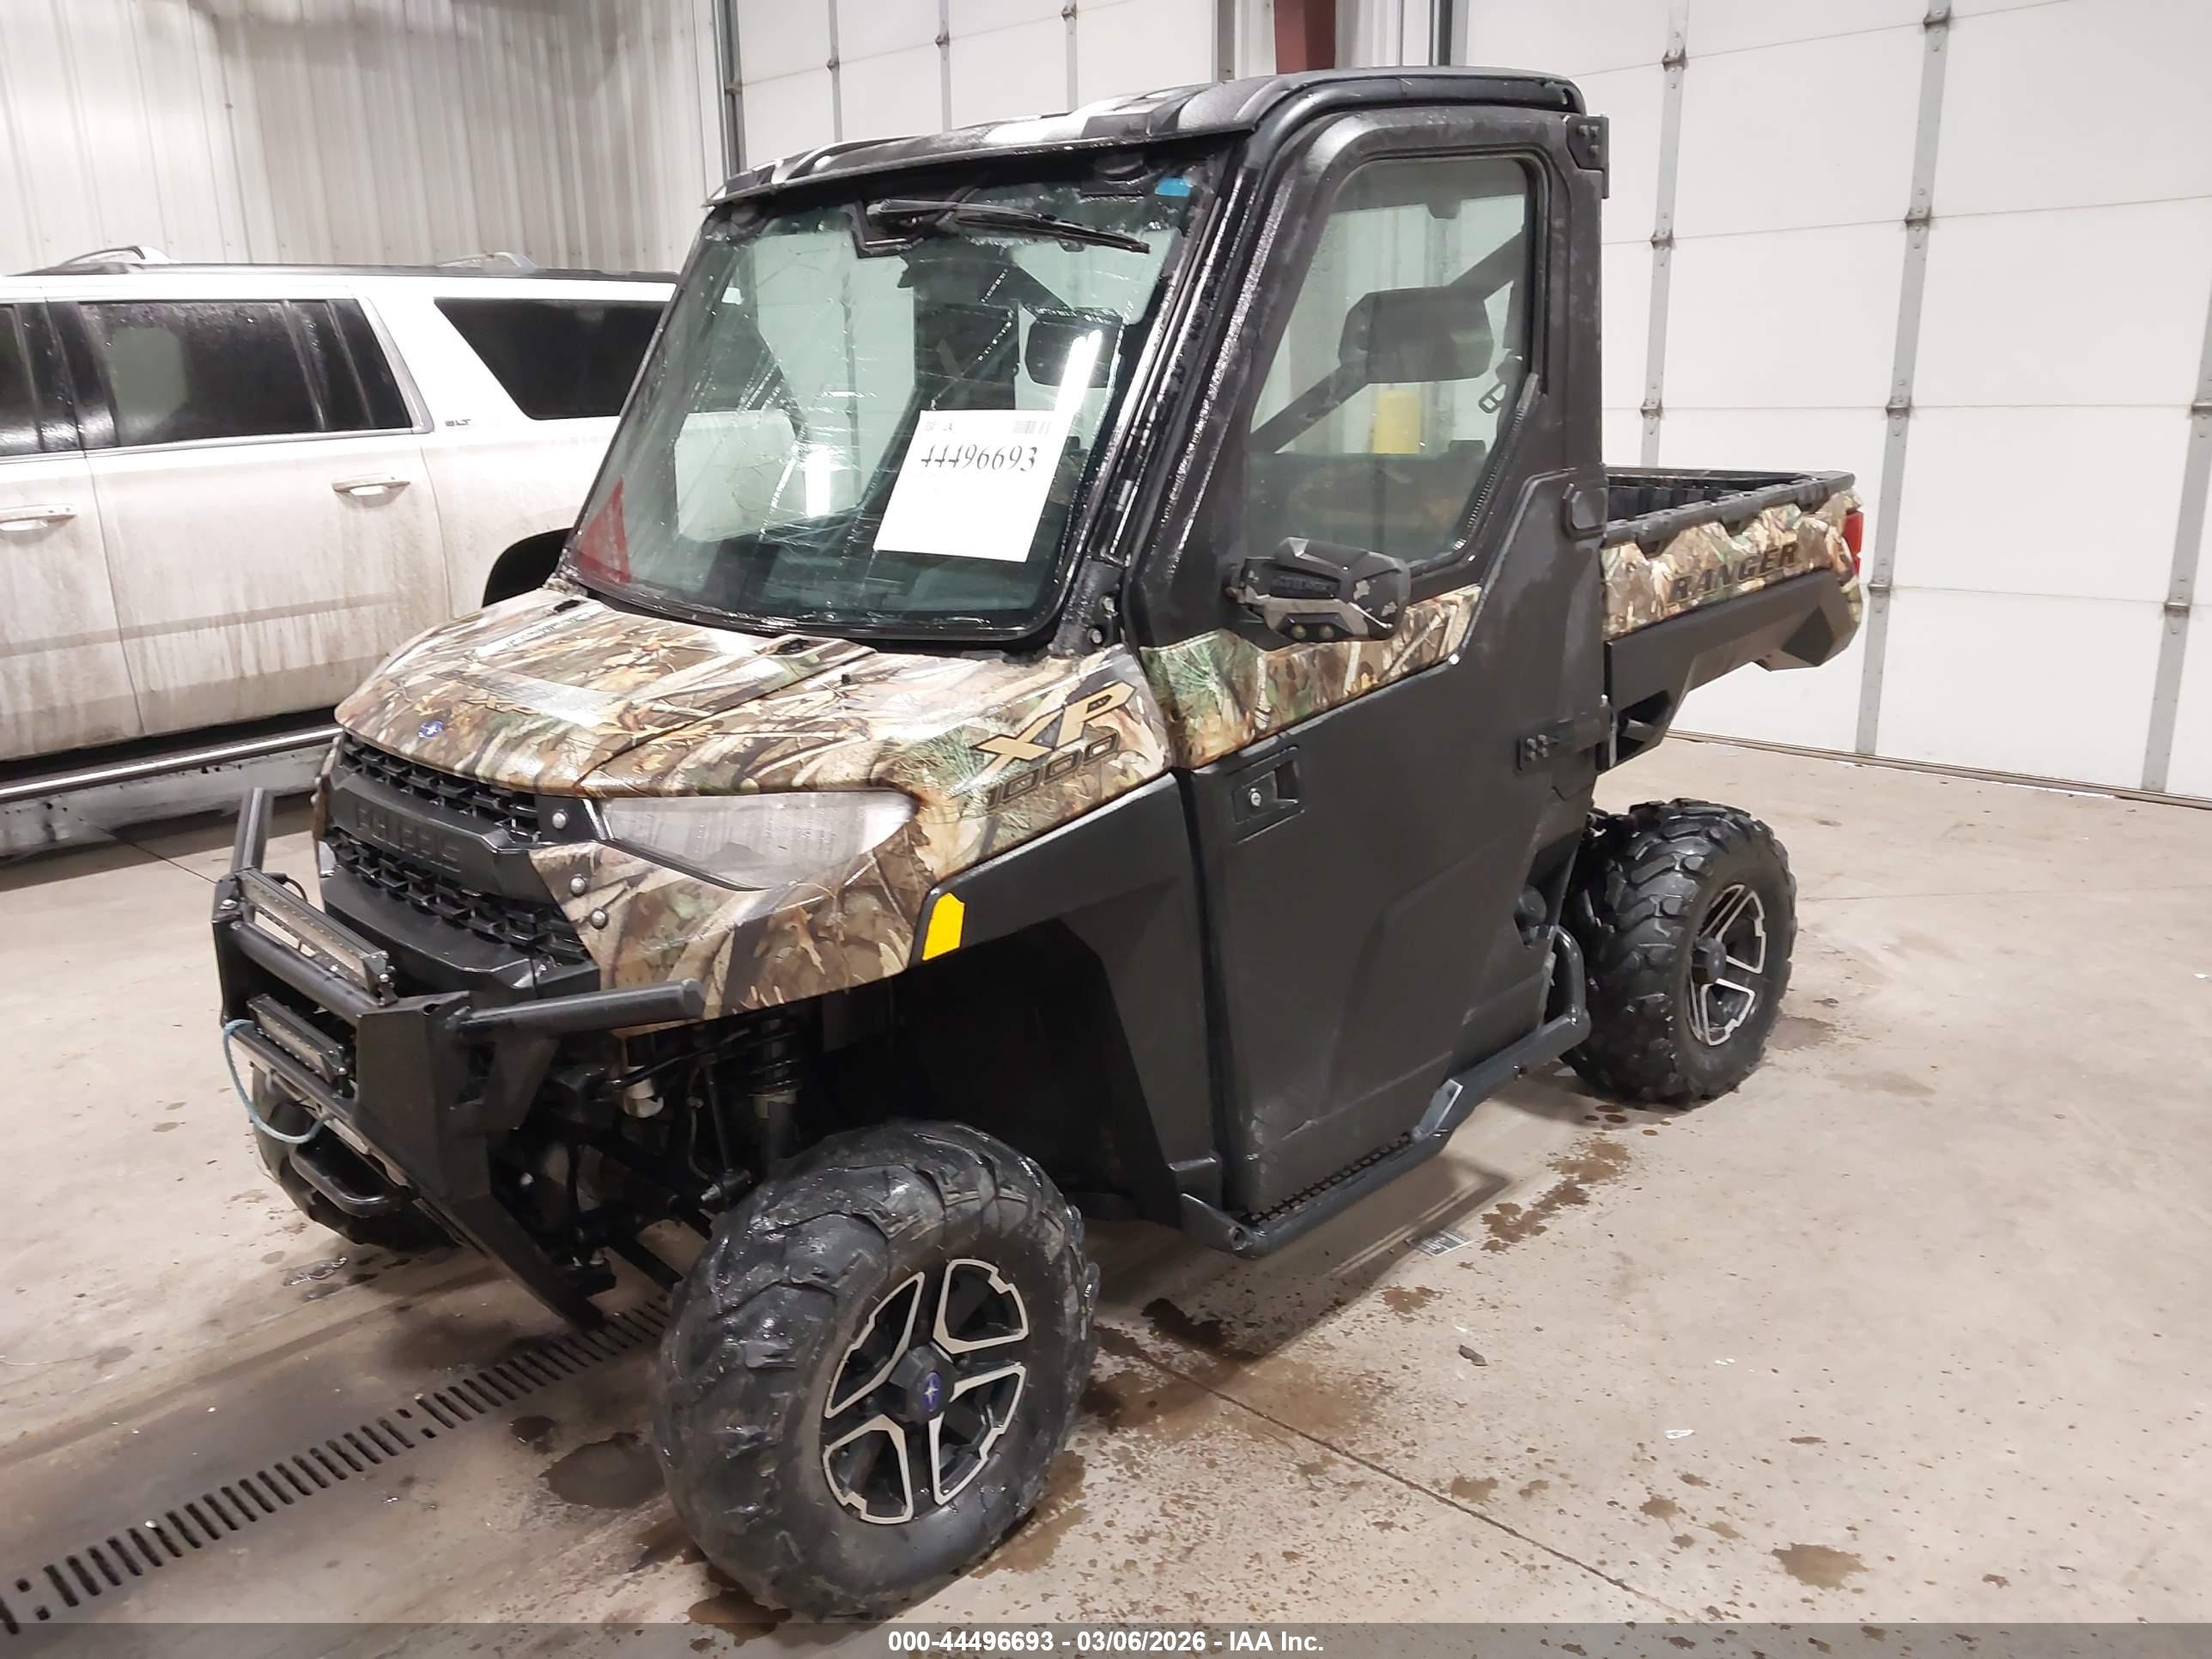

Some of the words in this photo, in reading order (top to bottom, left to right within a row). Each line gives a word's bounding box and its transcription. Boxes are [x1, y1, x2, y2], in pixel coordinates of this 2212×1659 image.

[920, 443, 1038, 472] 44496693
[1670, 542, 1799, 599] RANGER
[951, 681, 1136, 798] XP
[987, 731, 1120, 811] 1000
